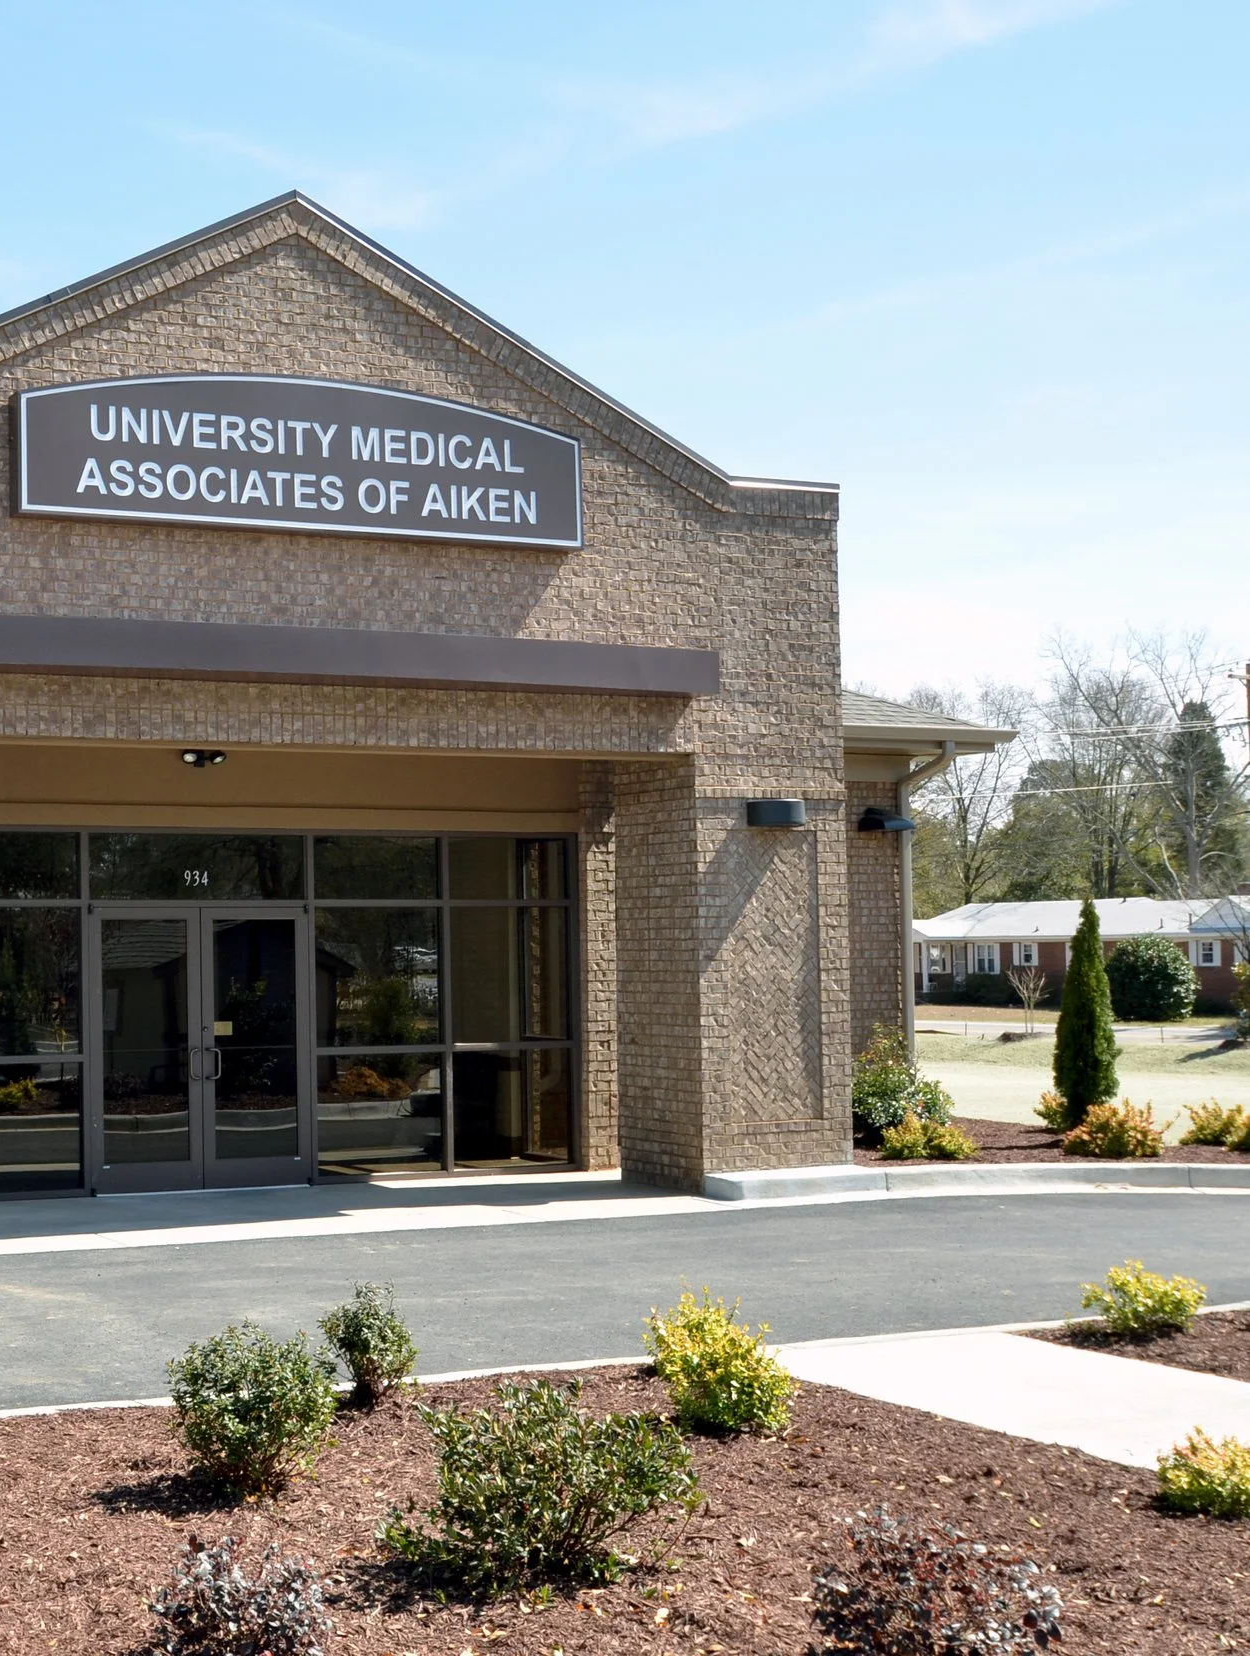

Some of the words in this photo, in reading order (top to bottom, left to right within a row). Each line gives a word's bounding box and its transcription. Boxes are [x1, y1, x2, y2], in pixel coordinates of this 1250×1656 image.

[90, 403, 339, 458] UNIVERSITY
[351, 425, 525, 474] MEDICAL
[75, 457, 345, 512] ASSOCIATES
[357, 477, 410, 515] OF
[420, 483, 537, 525] AIKEN
[183, 869, 210, 887] 934
